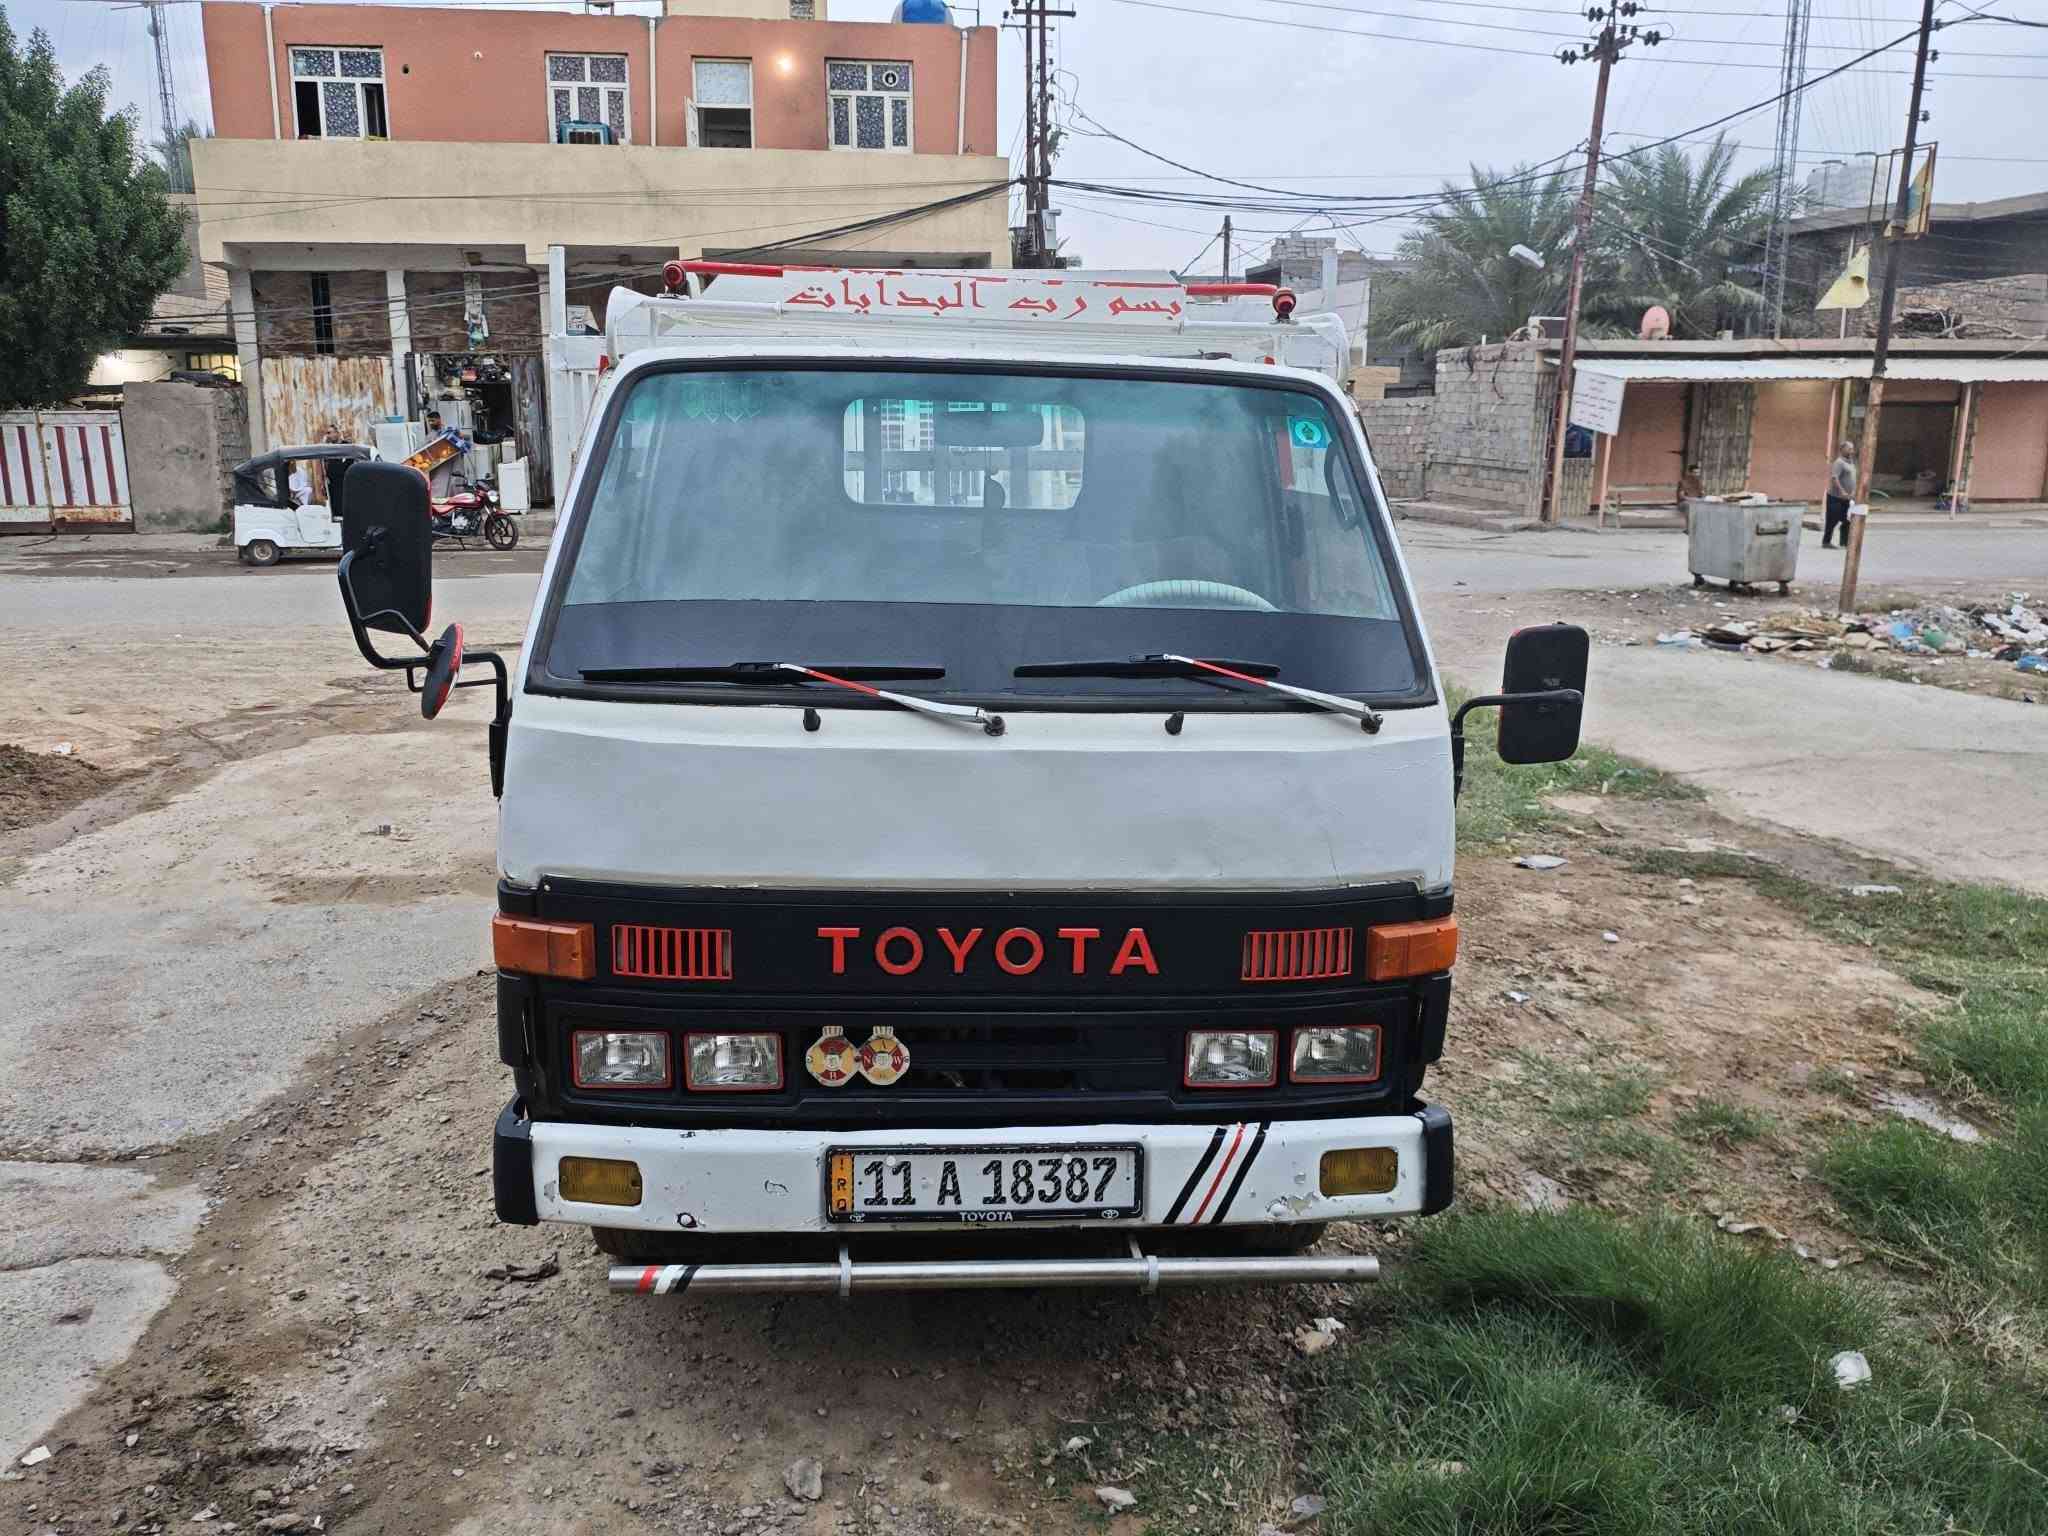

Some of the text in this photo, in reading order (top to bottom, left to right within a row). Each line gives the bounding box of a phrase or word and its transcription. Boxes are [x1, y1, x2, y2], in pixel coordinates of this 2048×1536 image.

[785, 277, 1182, 320] بسم رب البدايات
[817, 926, 1160, 975] TOYOTA
[863, 1156, 1118, 1206] 11 A 18387
[959, 1211, 1014, 1222] TOYOTA
